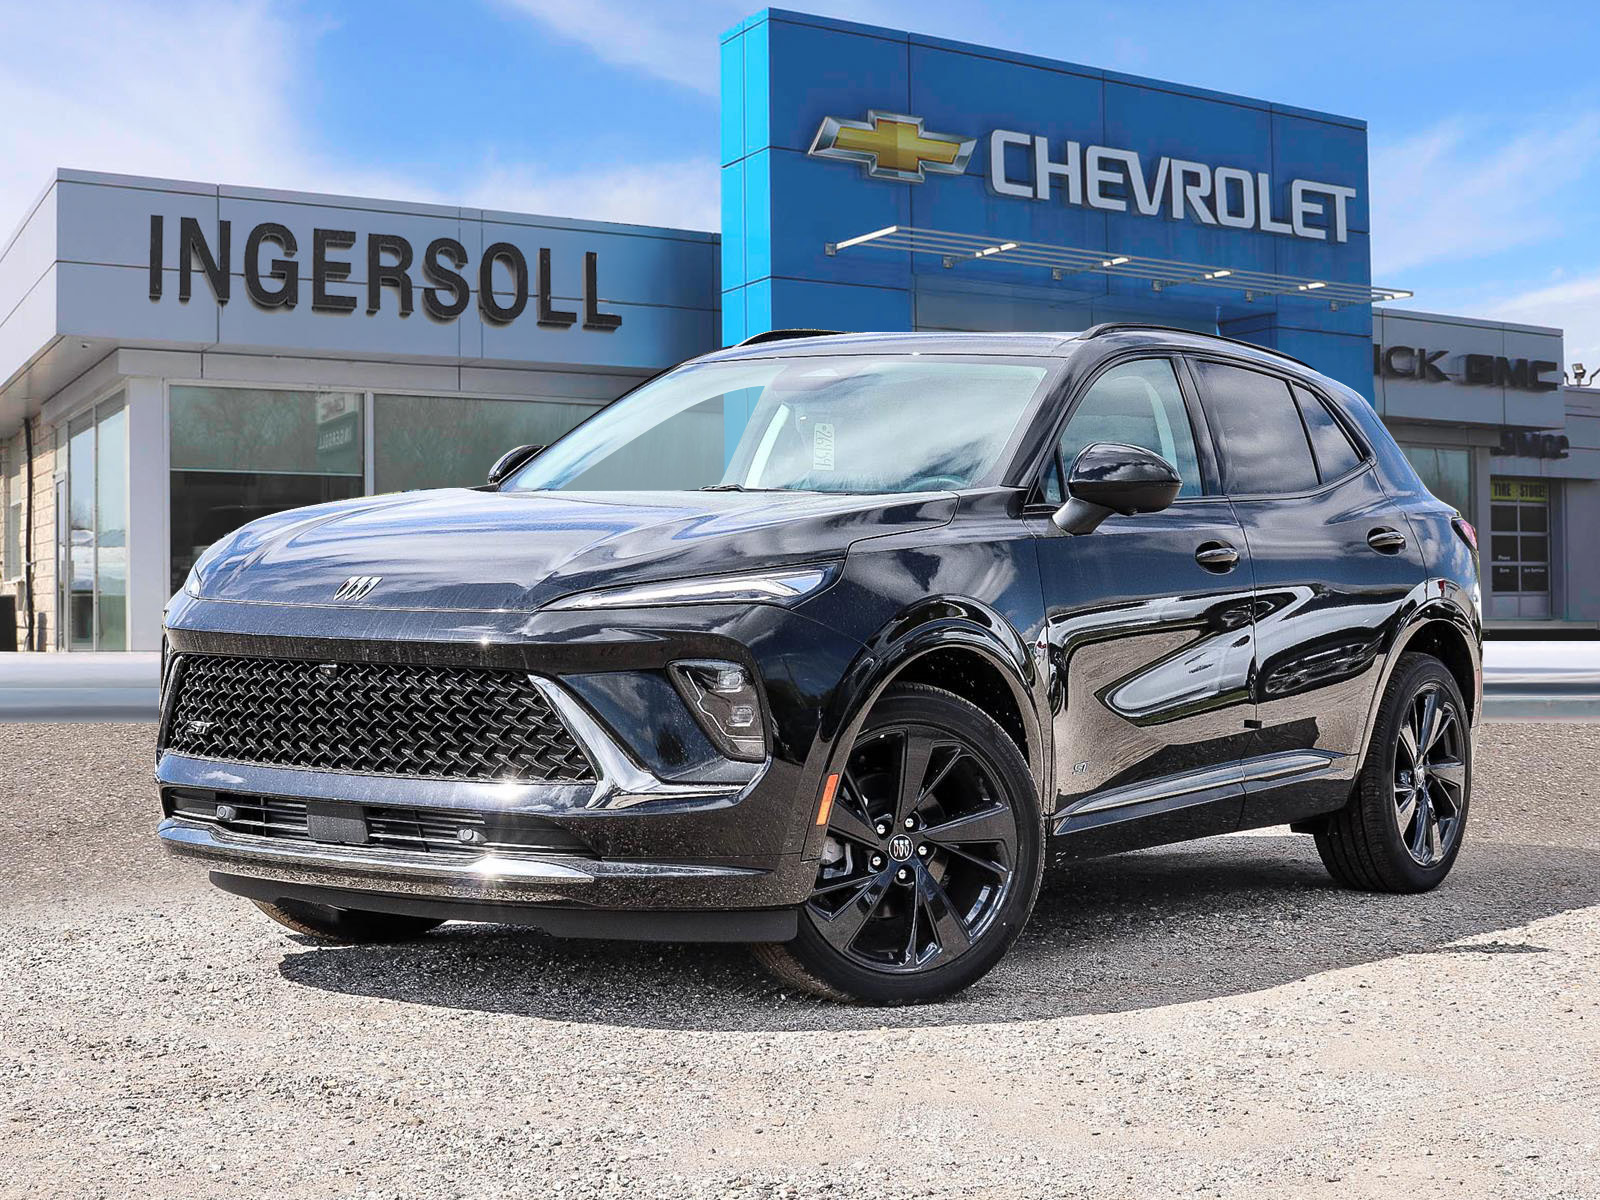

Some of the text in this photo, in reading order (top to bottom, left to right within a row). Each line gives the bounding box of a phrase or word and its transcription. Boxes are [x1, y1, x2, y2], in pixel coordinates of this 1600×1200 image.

[988, 128, 1357, 243] CHEVROLET
[149, 214, 623, 332] INGERSOLL
[1373, 343, 1451, 381] ICK
